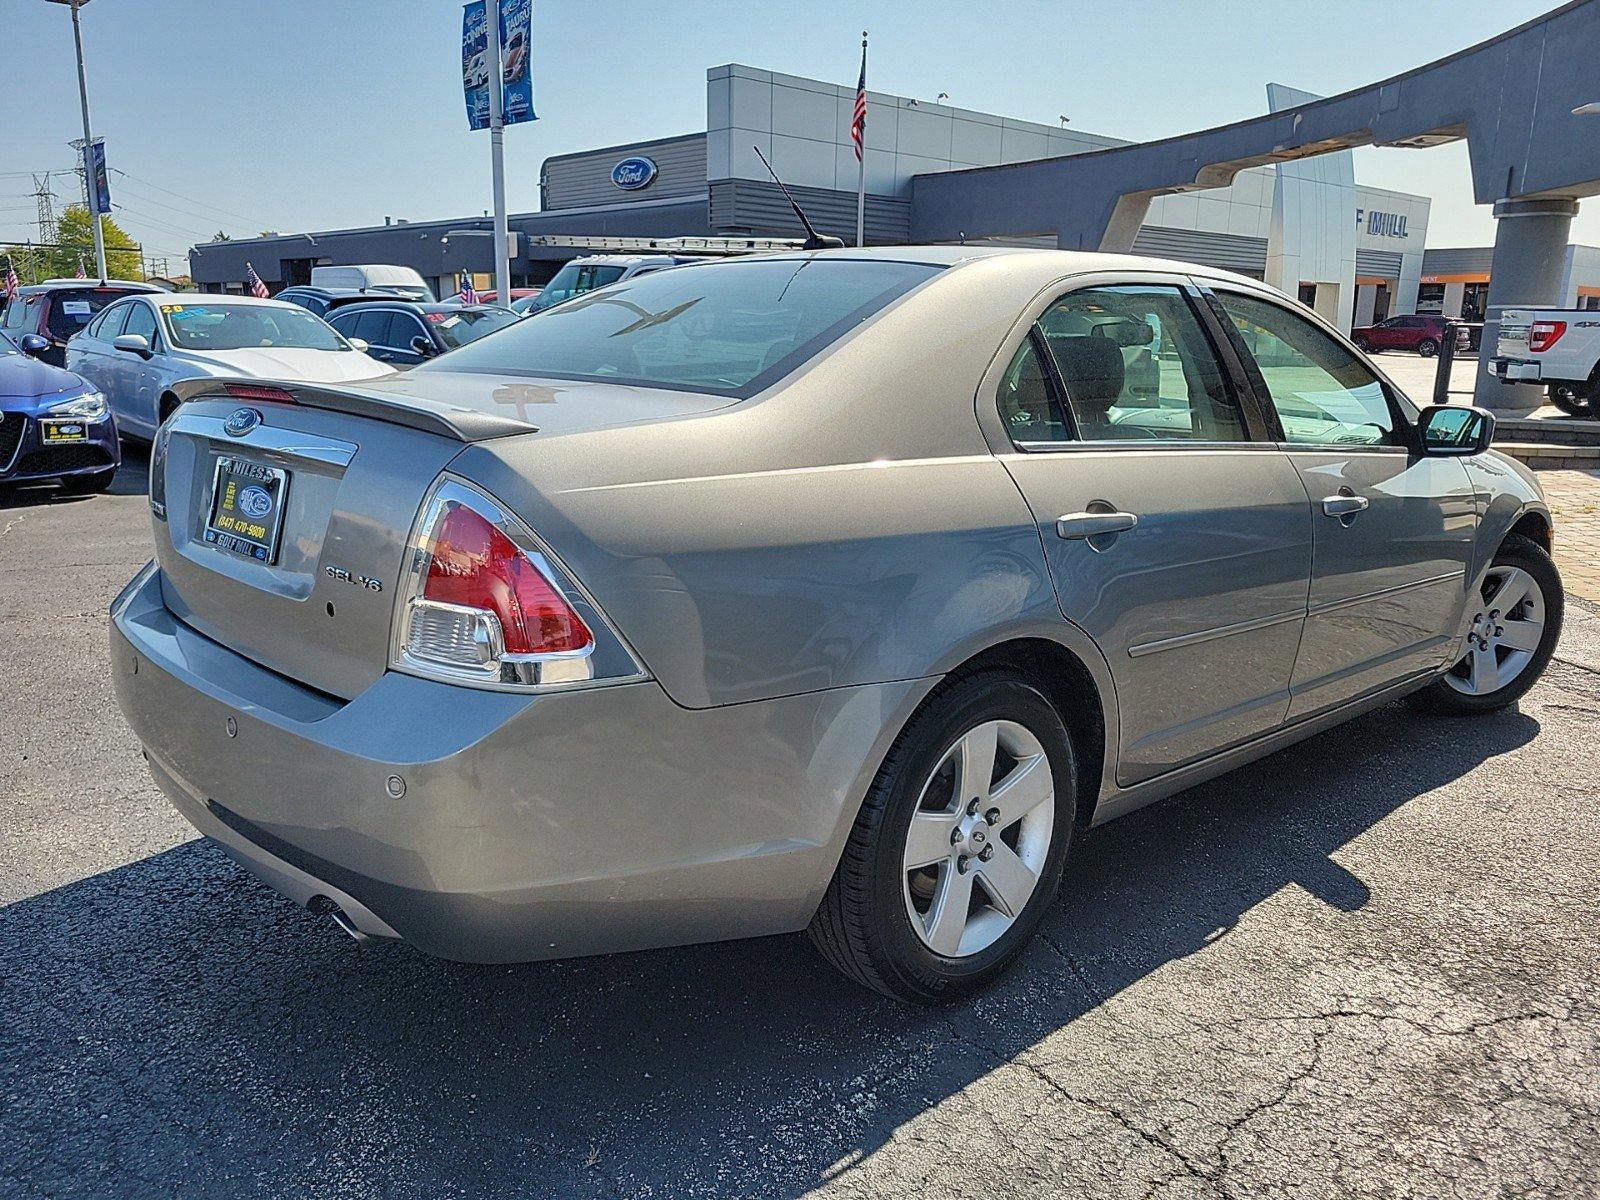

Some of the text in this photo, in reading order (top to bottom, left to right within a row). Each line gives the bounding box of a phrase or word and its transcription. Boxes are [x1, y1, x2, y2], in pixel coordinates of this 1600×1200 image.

[618, 165, 643, 183] Ford
[1367, 211, 1408, 239] MILL
[228, 409, 250, 427] Ford
[232, 461, 265, 480] NILES
[217, 534, 253, 556] GOLF MILL
[325, 566, 383, 592] SEL V6
